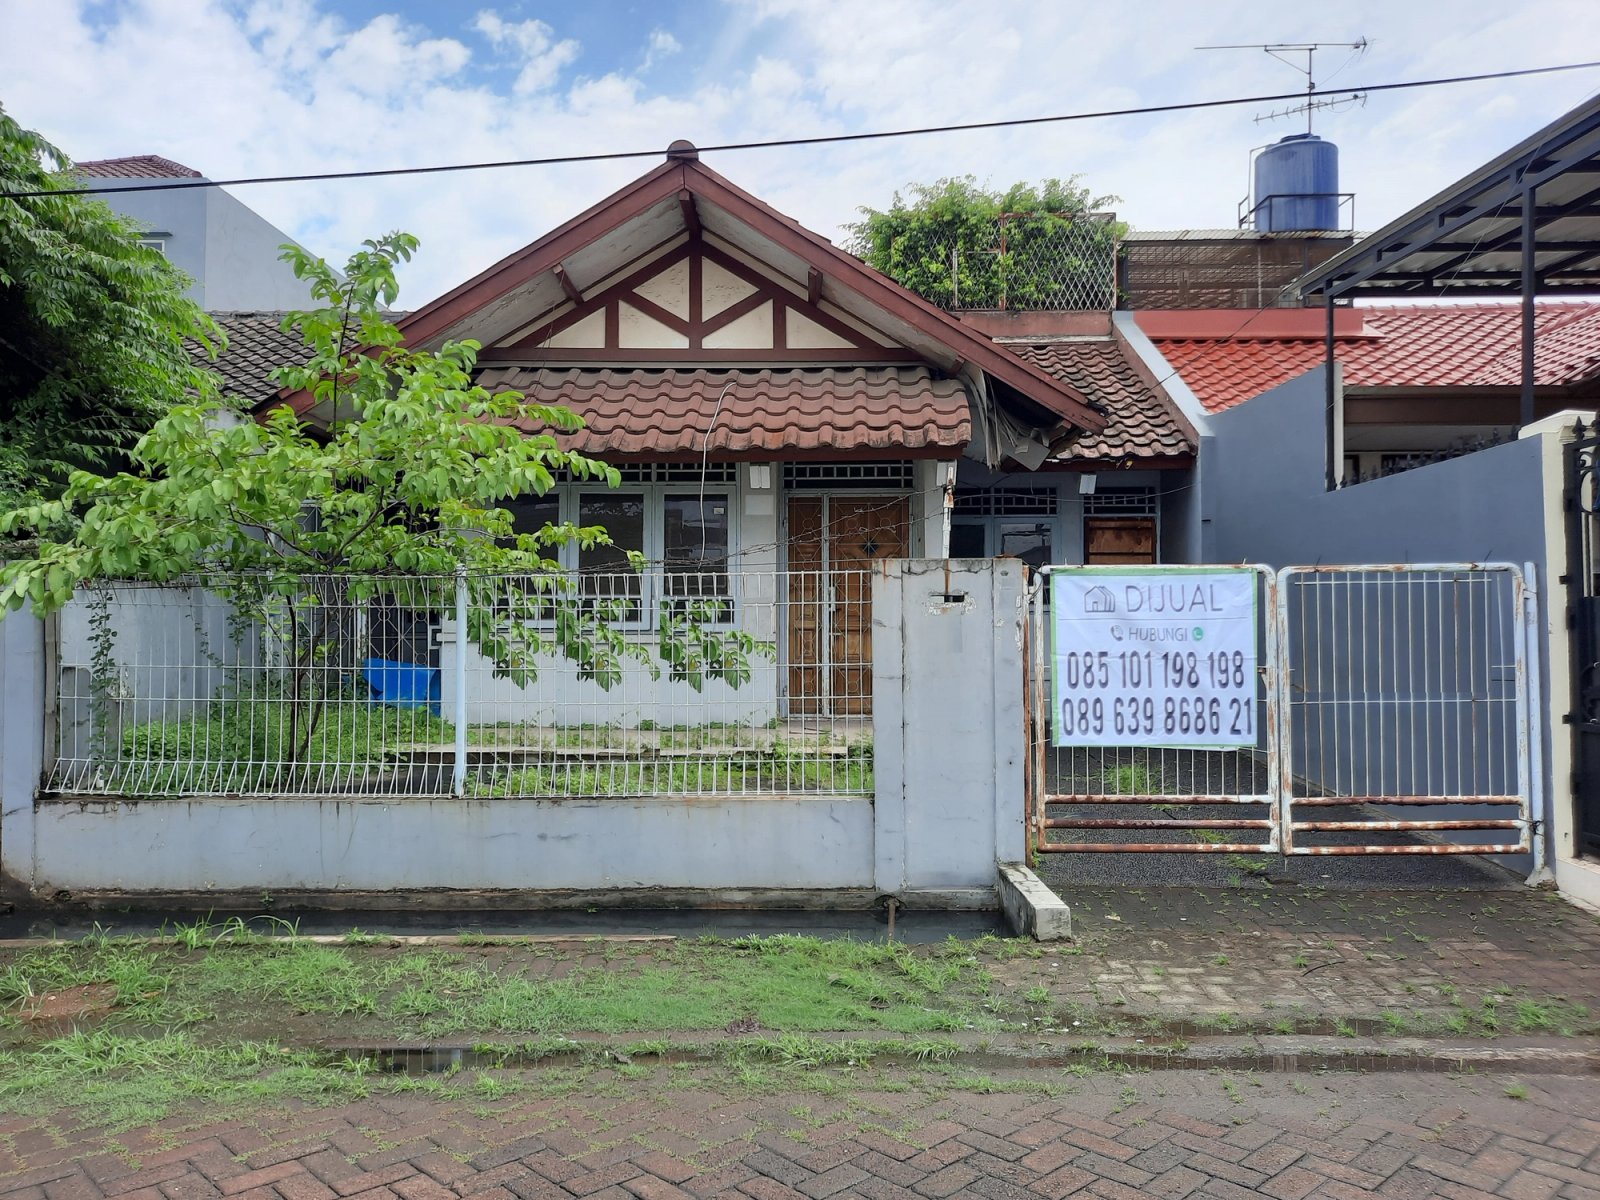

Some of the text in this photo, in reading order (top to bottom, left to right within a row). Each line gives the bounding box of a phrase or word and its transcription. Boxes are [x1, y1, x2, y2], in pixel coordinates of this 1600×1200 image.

[1125, 584, 1223, 613] DIJUAL
[1128, 627, 1188, 642] HUBUNGI
[1067, 650, 1244, 689] 085 101 198 198
[1062, 696, 1252, 736] 089 639 8686 21
